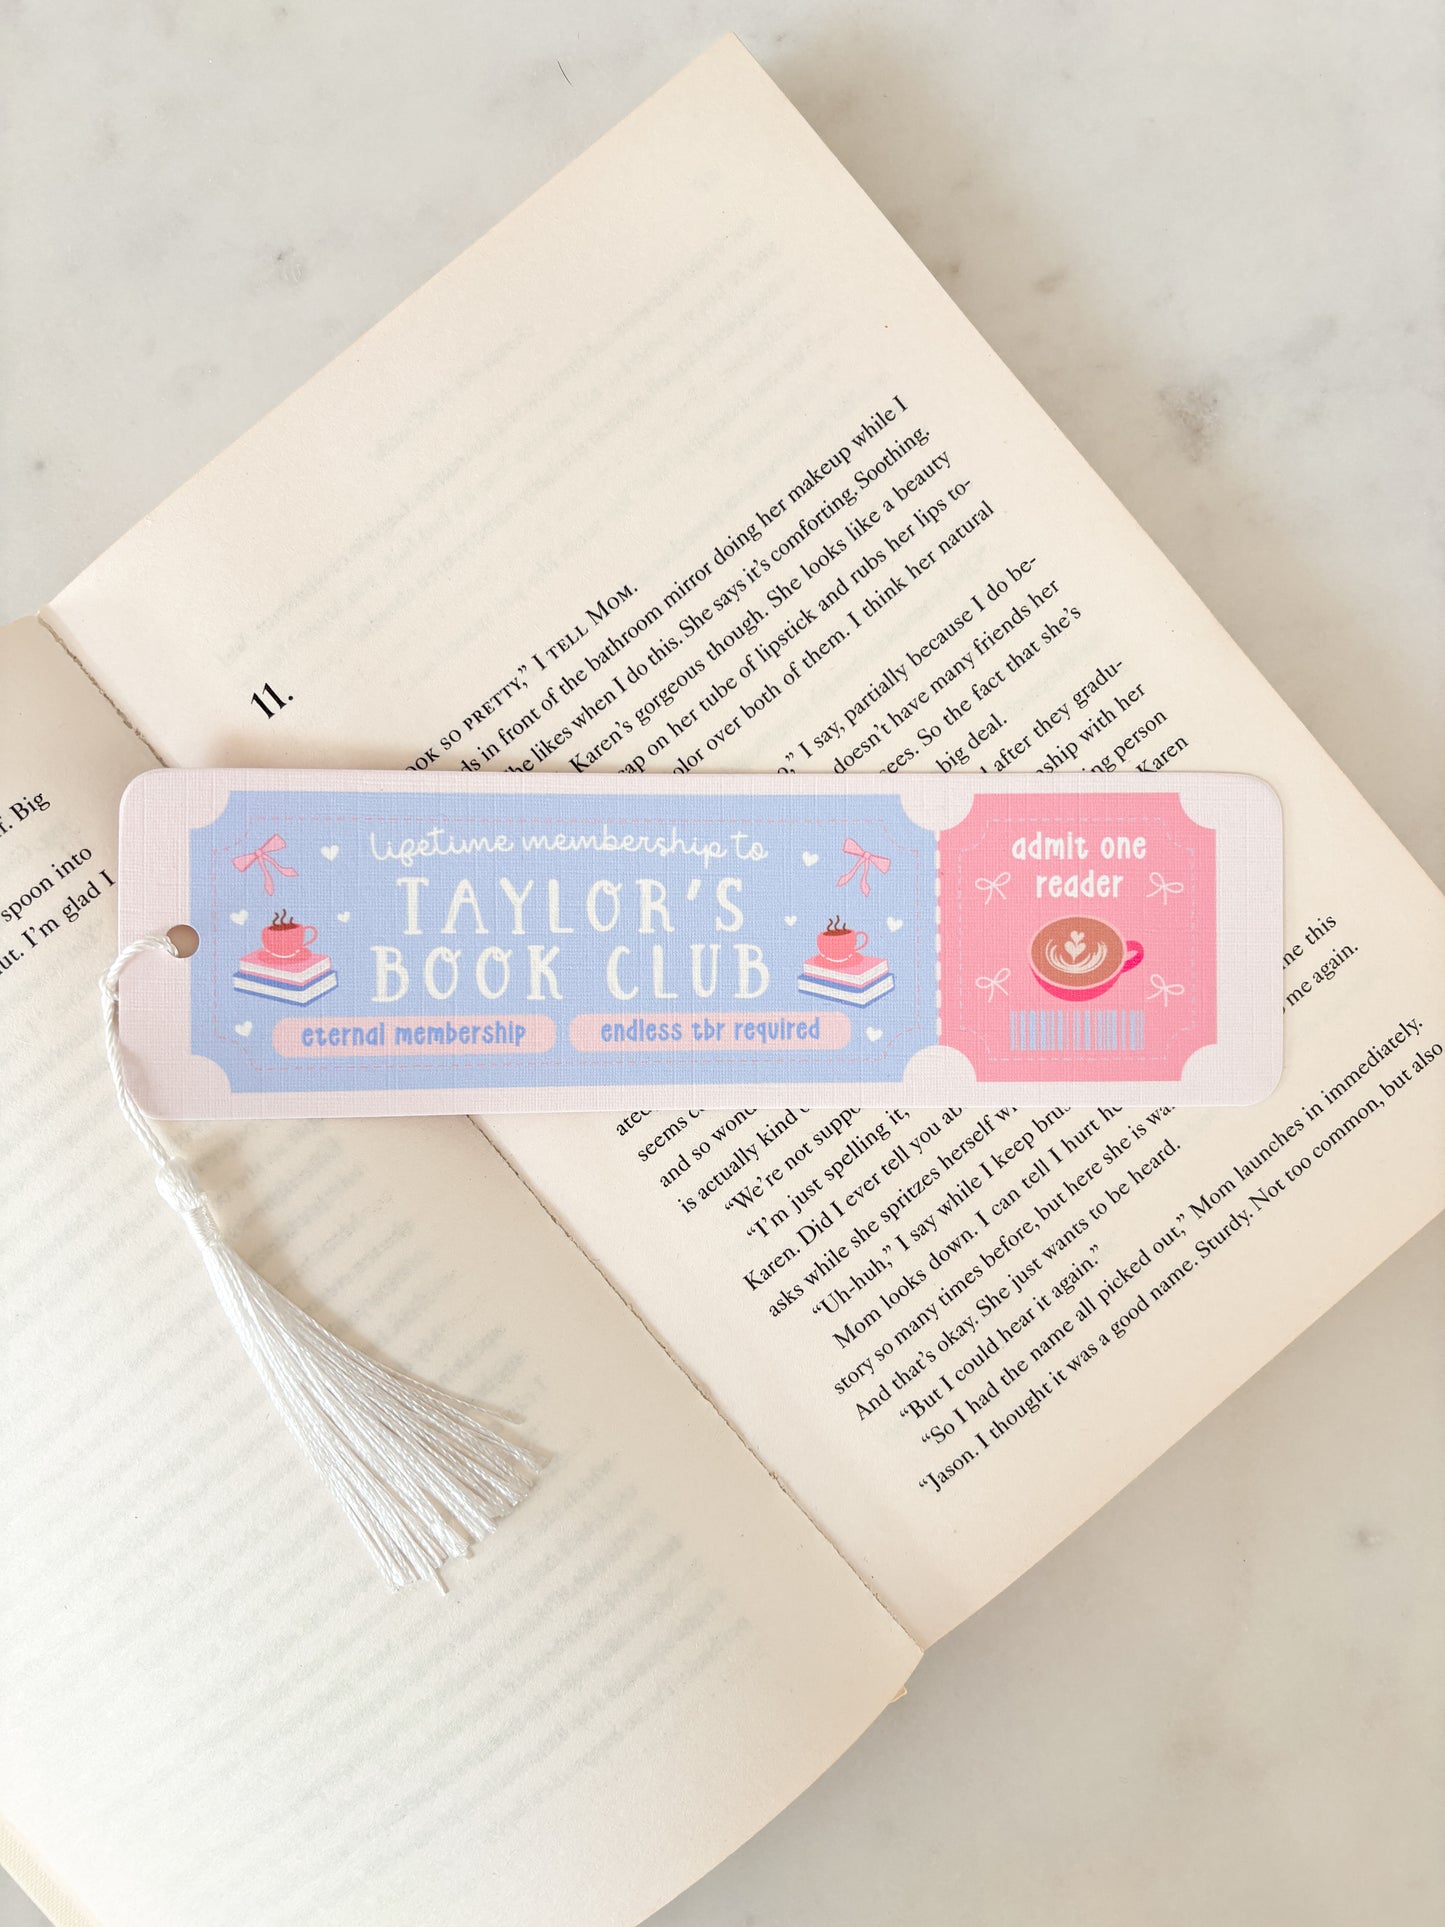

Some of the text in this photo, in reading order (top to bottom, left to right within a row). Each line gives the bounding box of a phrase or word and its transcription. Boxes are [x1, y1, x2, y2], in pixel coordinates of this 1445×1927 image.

[476, 394, 908, 763] in front of the bathroom mirror doing her makeup while I
[529, 428, 930, 764] likes when I do this. She says it's comforting. Soothing.
[567, 451, 951, 774] Karen's gorgeous though. She looks like a beauty
[706, 499, 995, 751] over both of them. I think her natural
[797, 557, 1036, 759] I say, partially because I do be-
[250, 682, 294, 720] 11.
[439, 729, 462, 751] SO
[531, 653, 548, 671] I
[545, 625, 589, 660] TELL
[833, 723, 892, 775] doesn't
[886, 691, 930, 728] have
[929, 651, 975, 695] many
[972, 605, 1032, 656] friends
[1026, 579, 1059, 609] her
[993, 661, 1123, 773] after they gradu-
[935, 712, 1008, 774] big deal.
[1113, 711, 1168, 764] person
[9, 793, 51, 822] Big
[370, 826, 768, 868] lifetime membership to
[1012, 831, 1146, 860] admit one
[1, 848, 92, 922] spoon into
[21, 869, 116, 948] I'm glad I
[396, 877, 743, 935] TAYLOR'S
[1037, 870, 1123, 898] reader
[370, 944, 770, 1002] BOOK CLUB
[1285, 945, 1359, 1007] me again.
[301, 1021, 526, 1047] eternal membership
[601, 1017, 819, 1044] endless tbr required
[637, 1116, 688, 1163] seems
[677, 1108, 799, 1214] is actually kind
[724, 1142, 814, 1211] "We're not
[746, 1108, 911, 1238] "I'm just spelling it,
[812, 1131, 1035, 1314] "Uh-huh," I say while I keep
[834, 1123, 1148, 1395] story so many times before, but here she is
[918, 1043, 1444, 1493] "Jason. I thought it was a good name. Sturdy. Not too common, but also
[921, 1018, 1423, 1445] "So I had the name all picked out," Mom launches in immediately.
[855, 1138, 1181, 1422] And that's okay. She just wants to be heard.
[899, 1243, 1099, 1419] "But I could hear it again."
